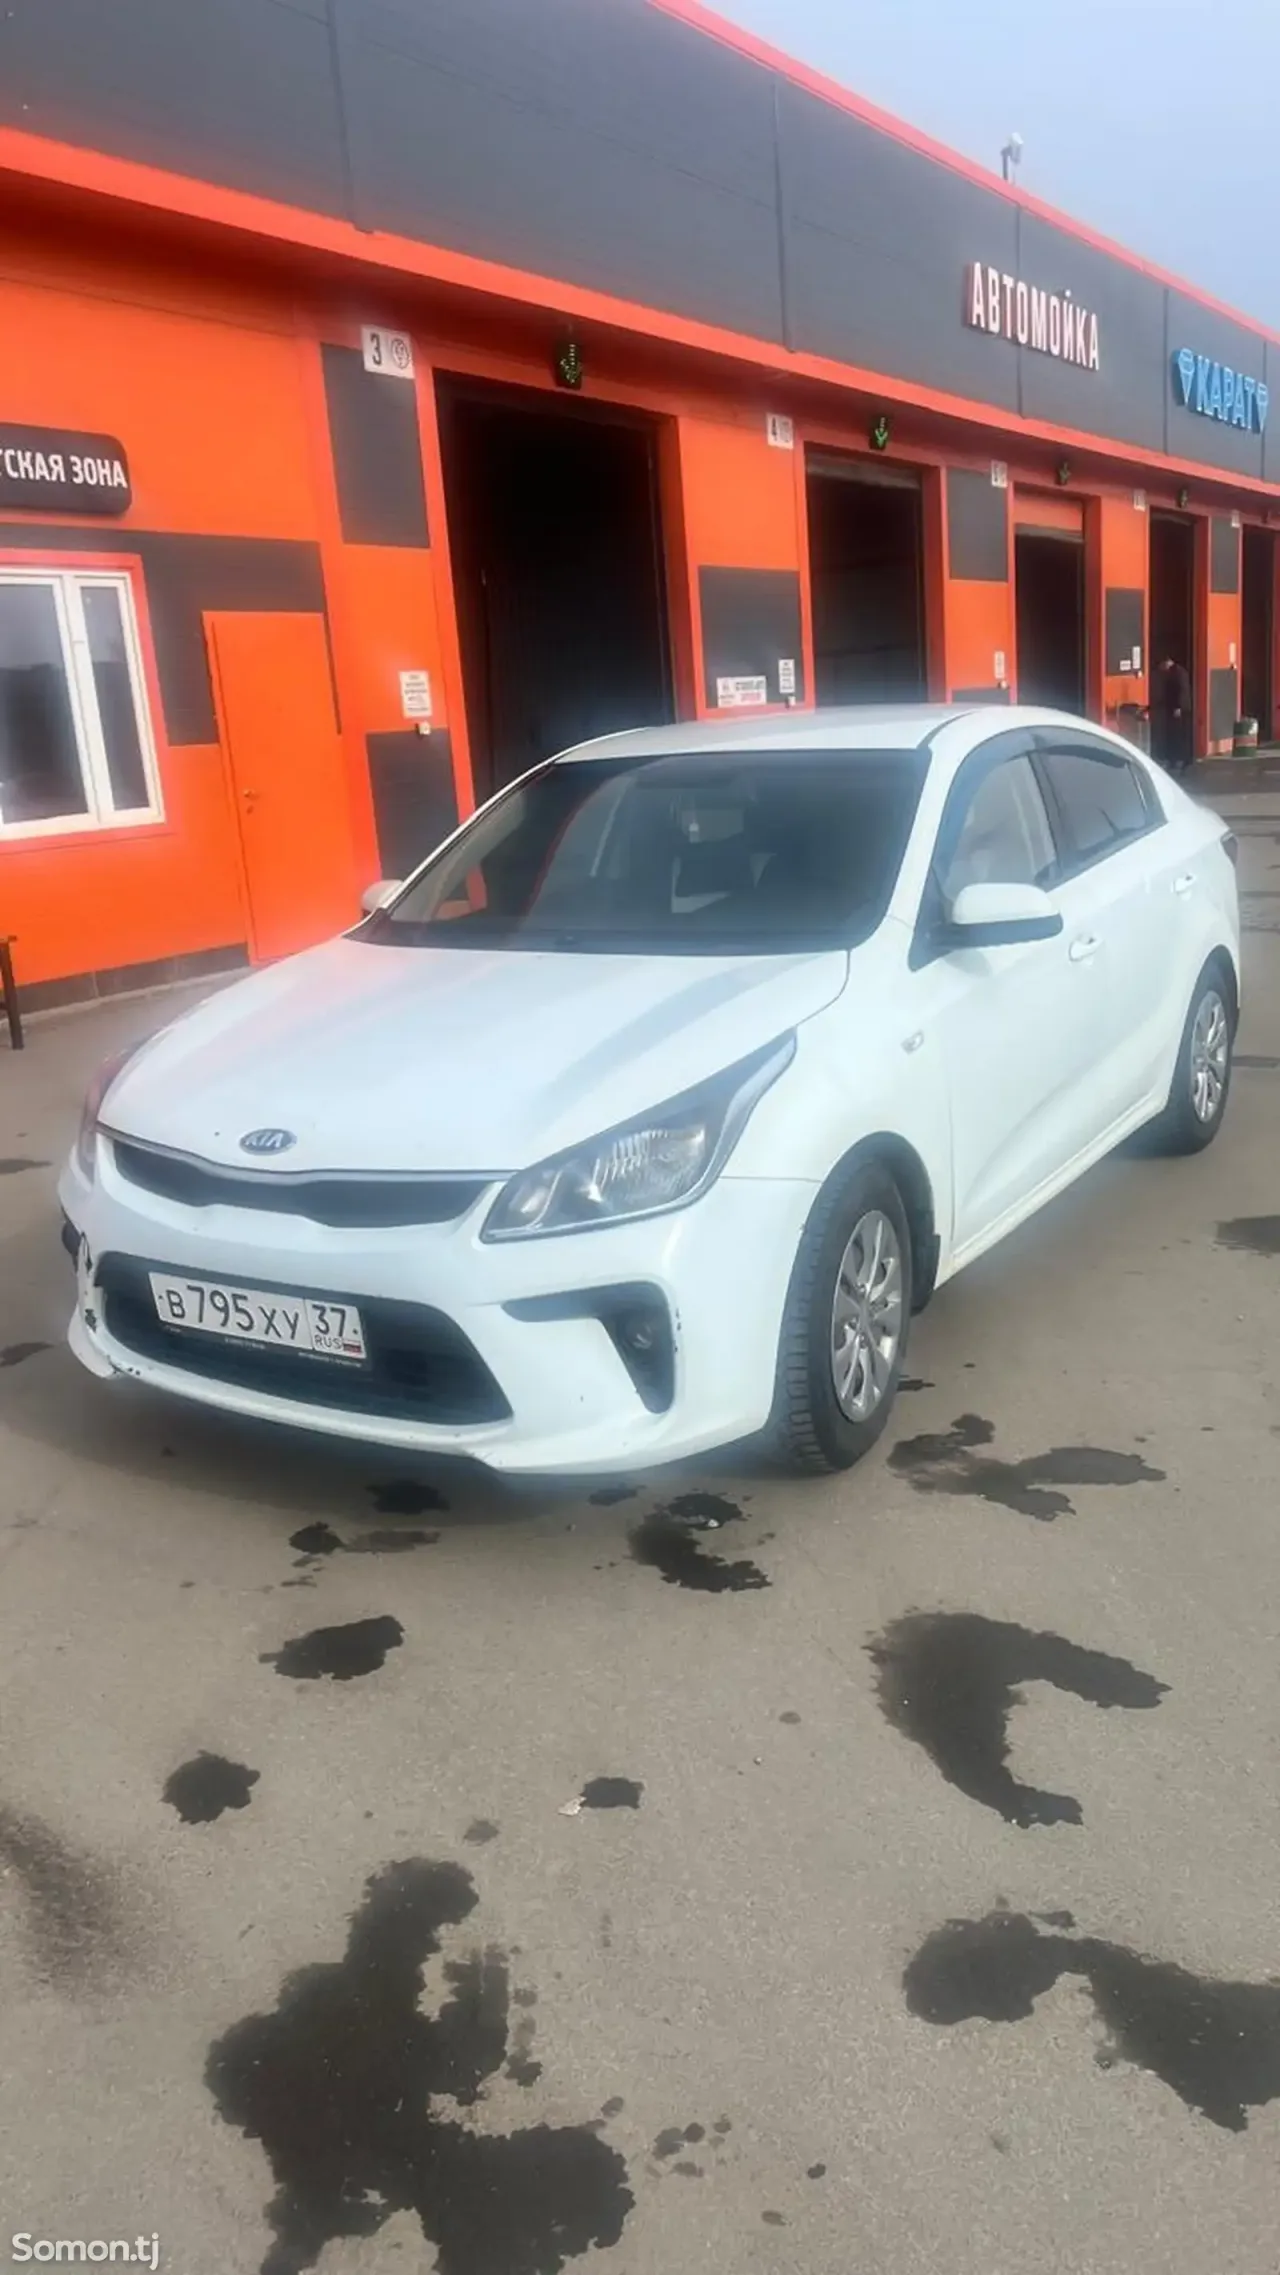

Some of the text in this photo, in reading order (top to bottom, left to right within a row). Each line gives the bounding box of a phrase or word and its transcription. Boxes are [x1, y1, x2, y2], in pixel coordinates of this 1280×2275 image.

[969, 261, 1099, 371] АВТОМОЙКА
[370, 332, 383, 367] 3
[1196, 355, 1255, 429] КАРАТ
[0, 448, 128, 488] СКАЯ ЗОНА
[241, 1129, 291, 1152] KIA
[312, 1303, 346, 1337] 37
[314, 1334, 342, 1350] RUS
